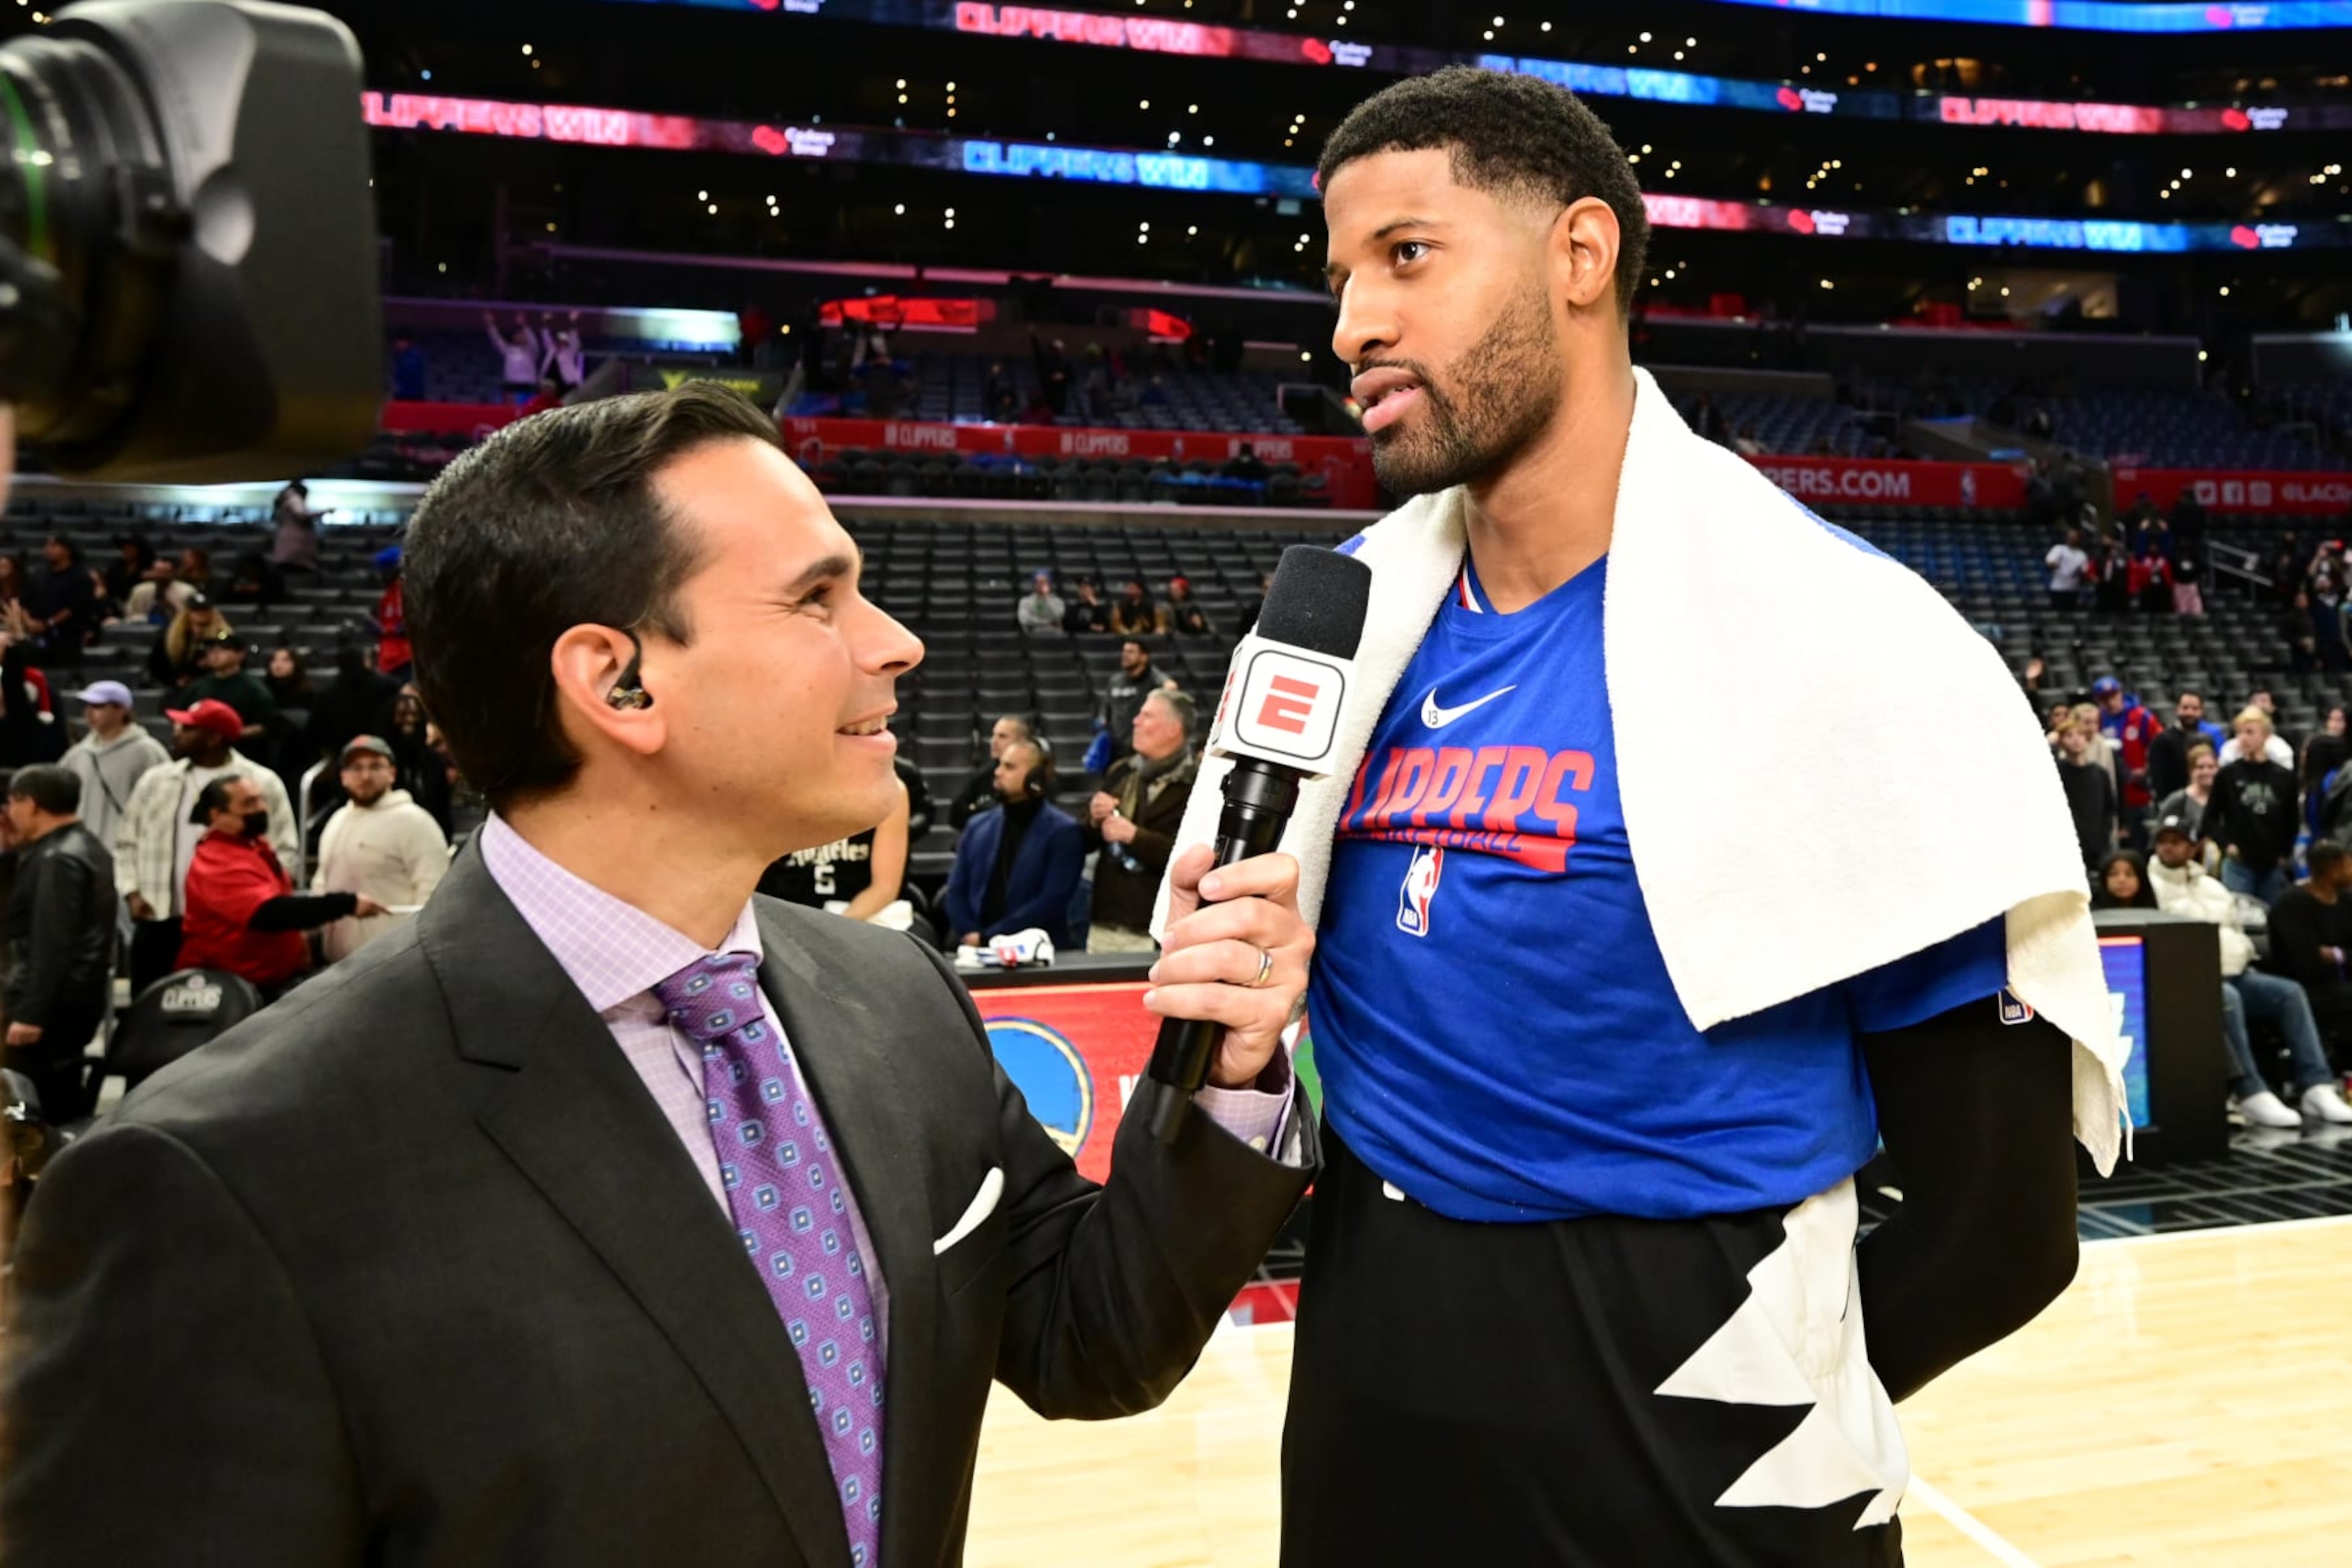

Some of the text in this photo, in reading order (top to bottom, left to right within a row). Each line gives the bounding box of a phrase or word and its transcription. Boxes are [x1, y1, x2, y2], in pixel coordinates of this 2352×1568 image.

[1126, 18, 1199, 53] WIN
[543, 105, 627, 145] WIN
[963, 140, 1208, 189] CLIPPERS WIN
[1256, 674, 1320, 735] E
[1427, 710, 1438, 725] 13
[813, 864, 835, 895] 5
[1401, 907, 1418, 928] NBA
[2004, 1004, 2022, 1019] NBA
